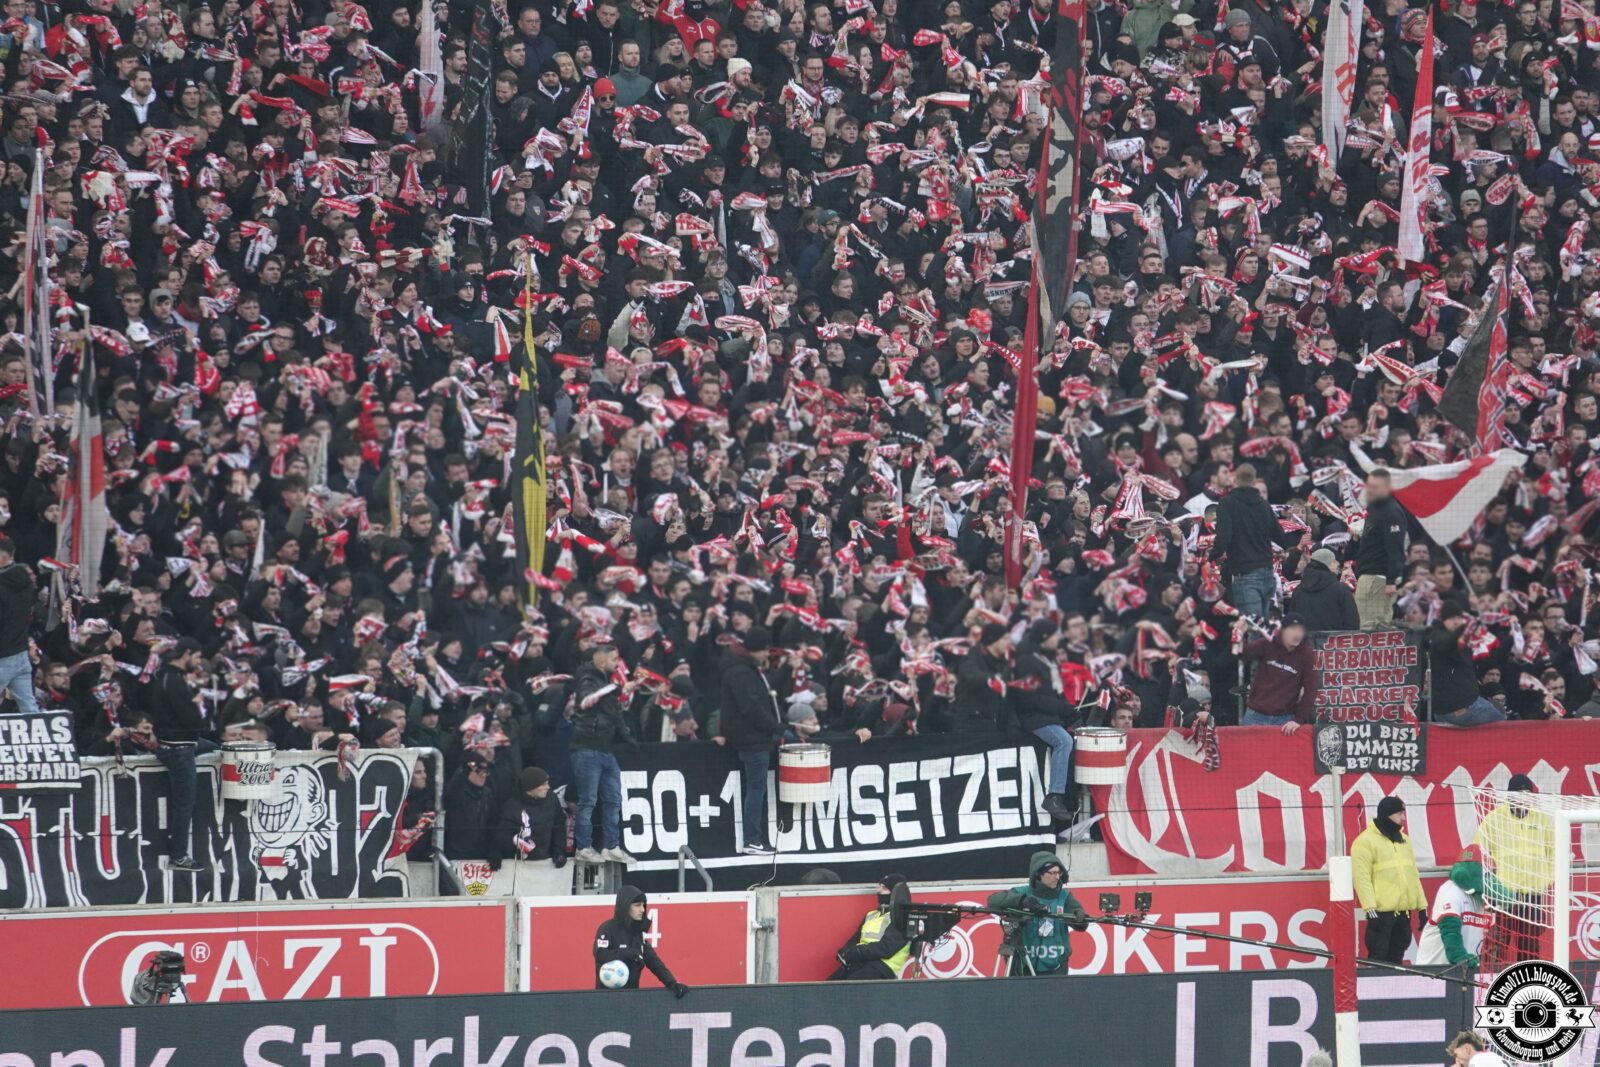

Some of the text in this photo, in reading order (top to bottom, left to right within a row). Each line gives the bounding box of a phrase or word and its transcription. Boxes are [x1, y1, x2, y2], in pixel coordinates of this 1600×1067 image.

[1324, 631, 1405, 650] JEDER
[1312, 646, 1418, 670] VERBANNTE
[1323, 667, 1409, 688] KEHRT
[1346, 724, 1420, 741] DU BIST
[1346, 739, 1419, 759] IMMER
[0, 762, 80, 781] RSTAND
[1346, 757, 1421, 772] BEI UNS!
[620, 745, 1052, 854] 50+1 UMSETZEN
[1024, 945, 1065, 959] HOST
[670, 1011, 947, 1067] Team
